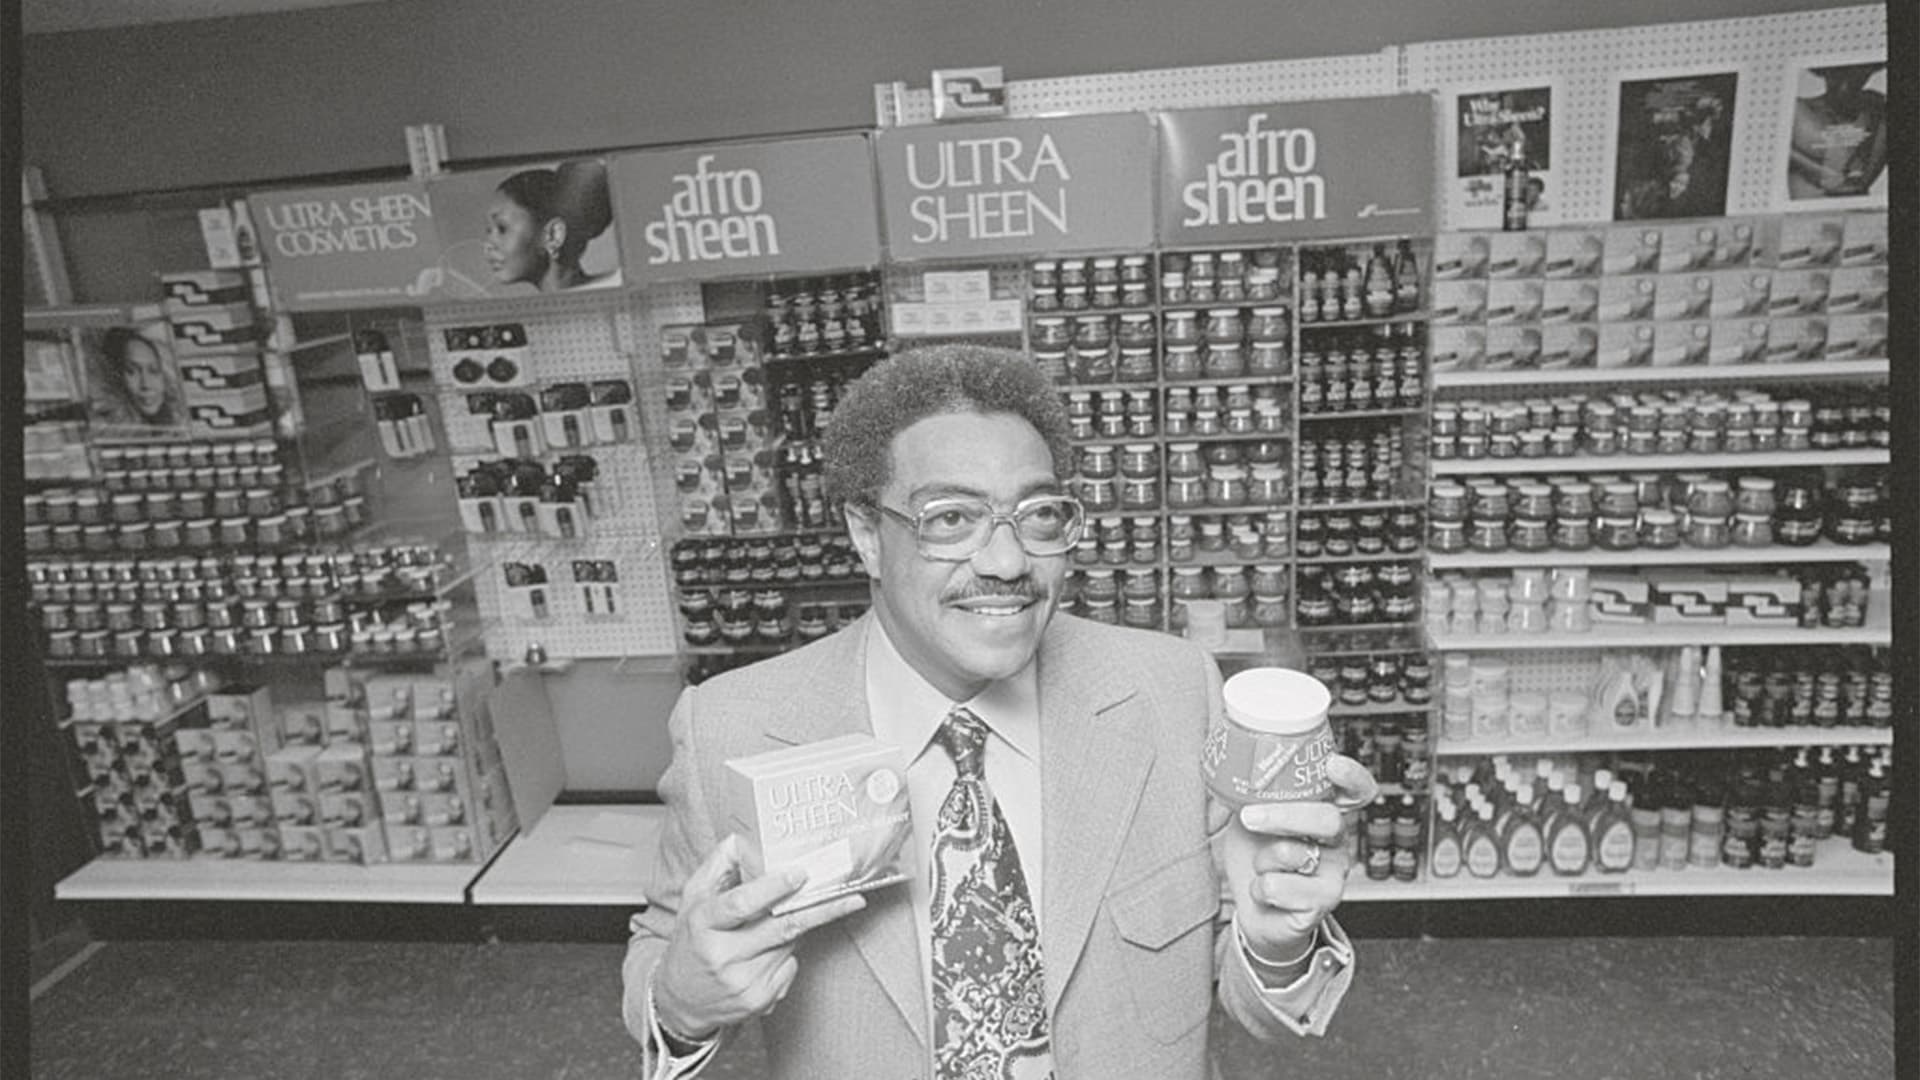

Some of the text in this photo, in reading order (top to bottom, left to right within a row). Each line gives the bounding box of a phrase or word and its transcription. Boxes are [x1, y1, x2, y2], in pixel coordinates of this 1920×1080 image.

[906, 132, 1071, 190] ULTRA
[1217, 112, 1316, 177] afro
[672, 154, 763, 217] afro
[1182, 163, 1327, 227] sheen
[264, 192, 433, 231] ULTRA SHEEN
[644, 204, 780, 265] sheen
[909, 186, 1068, 244] SHEEN
[275, 221, 418, 258] COSMETICS
[1293, 740, 1333, 767] ULTR
[1293, 758, 1329, 788] SHE
[769, 770, 855, 810] ULTRA
[772, 796, 859, 839] SHEEN
